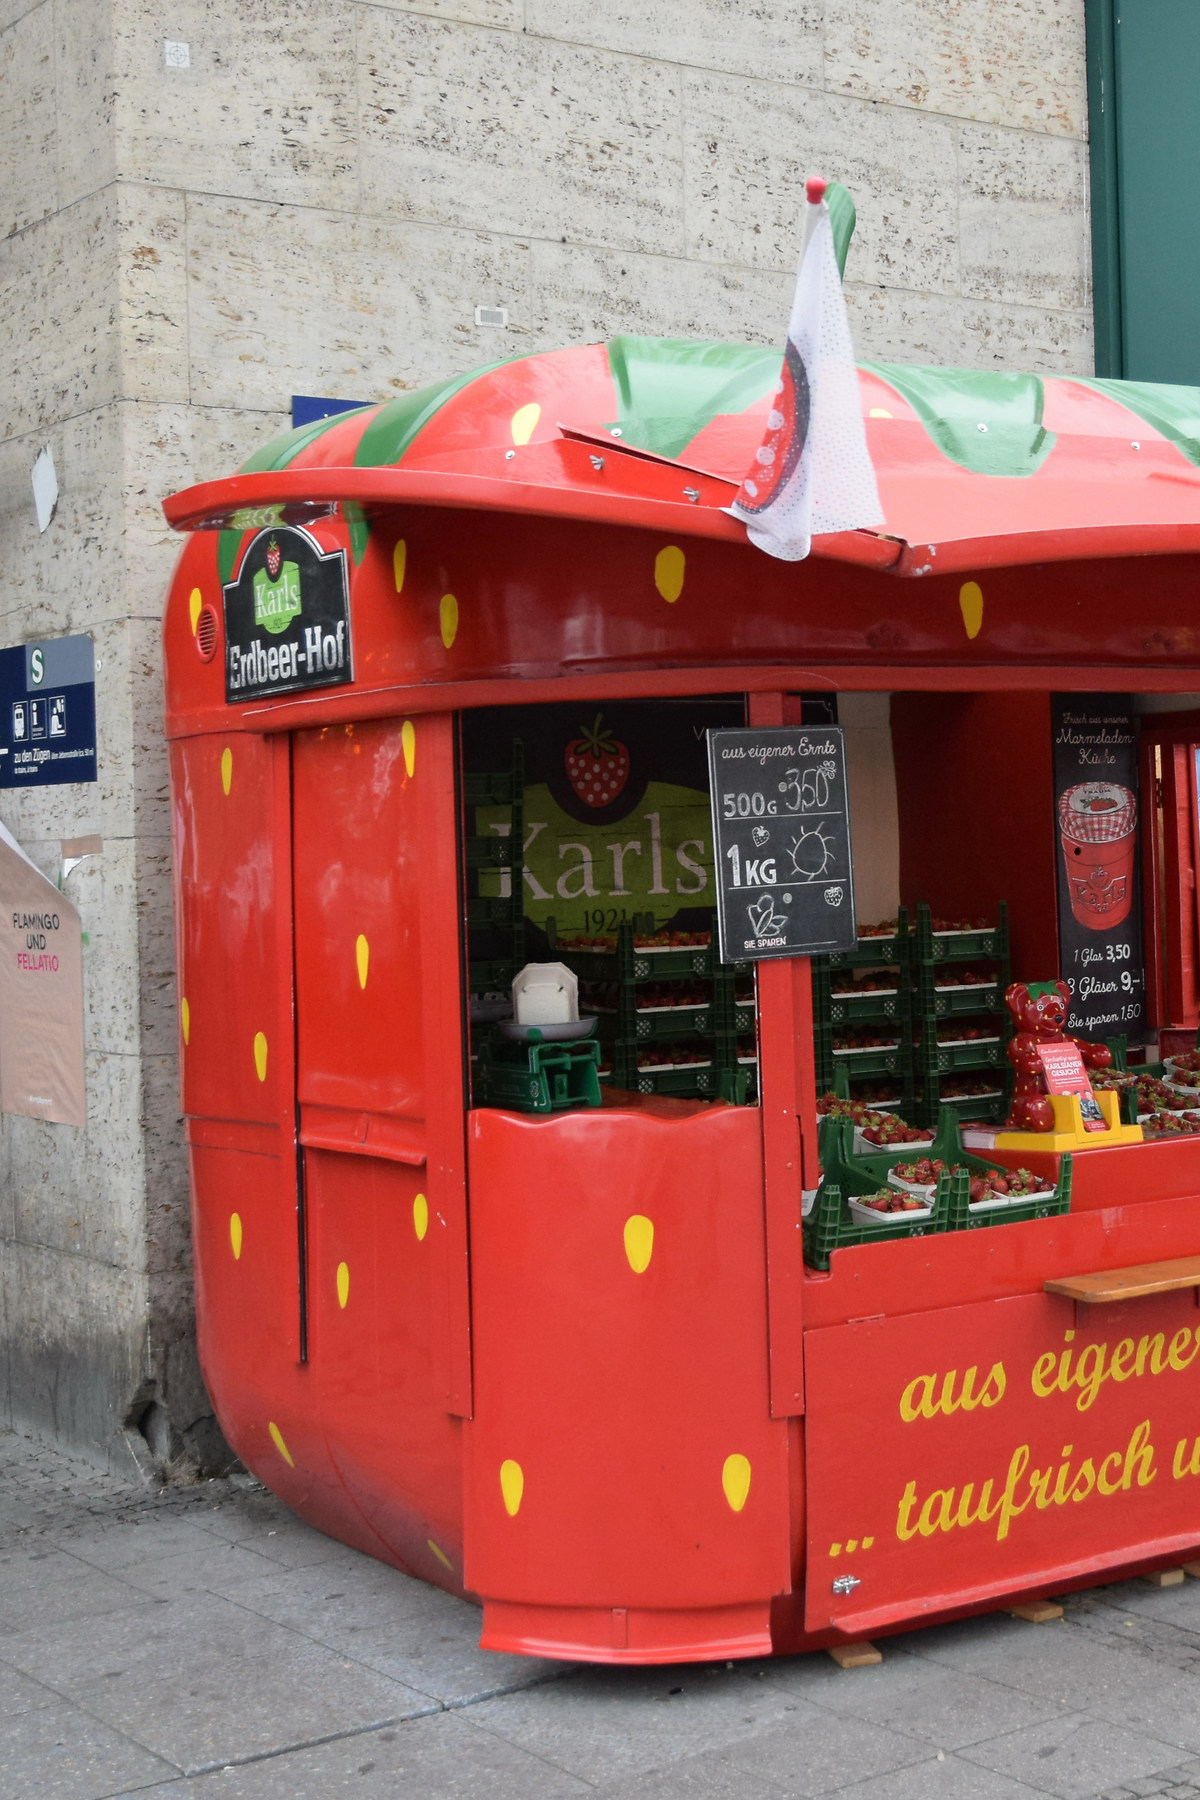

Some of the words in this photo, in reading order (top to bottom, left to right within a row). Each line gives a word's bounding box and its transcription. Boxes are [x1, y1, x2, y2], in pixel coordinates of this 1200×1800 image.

[255, 573, 300, 619] Karls
[229, 620, 345, 690] Erdbeer-Hof
[31, 648, 44, 684] S
[1056, 728, 1136, 745] Marmeladen-
[14, 753, 21, 764] zu
[21, 750, 32, 763] den
[33, 747, 51, 764] Zügen
[721, 745, 747, 759] aus
[748, 744, 796, 766] eigener
[798, 737, 837, 757] Ernte
[1078, 748, 1117, 765] Kühe
[489, 811, 708, 900] Karls
[13, 912, 60, 931] FLAMINGO
[26, 933, 47, 950] UND
[743, 939, 756, 949] SIE
[757, 936, 787, 948] SPAREN
[17, 953, 60, 972] FELLATIO
[1074, 949, 1078, 963] 1
[1080, 948, 1103, 967] Glas
[1106, 944, 1131, 962] 3,50
[1067, 978, 1075, 995] 3
[1078, 976, 1118, 1001] Gläser
[1067, 1012, 1084, 1029] Sie
[1084, 1013, 1119, 1031] sparen
[1051, 1068, 1080, 1077] GESUCHT
[899, 1360, 1007, 1423] aus
[896, 1418, 1158, 1541] taufrisch
